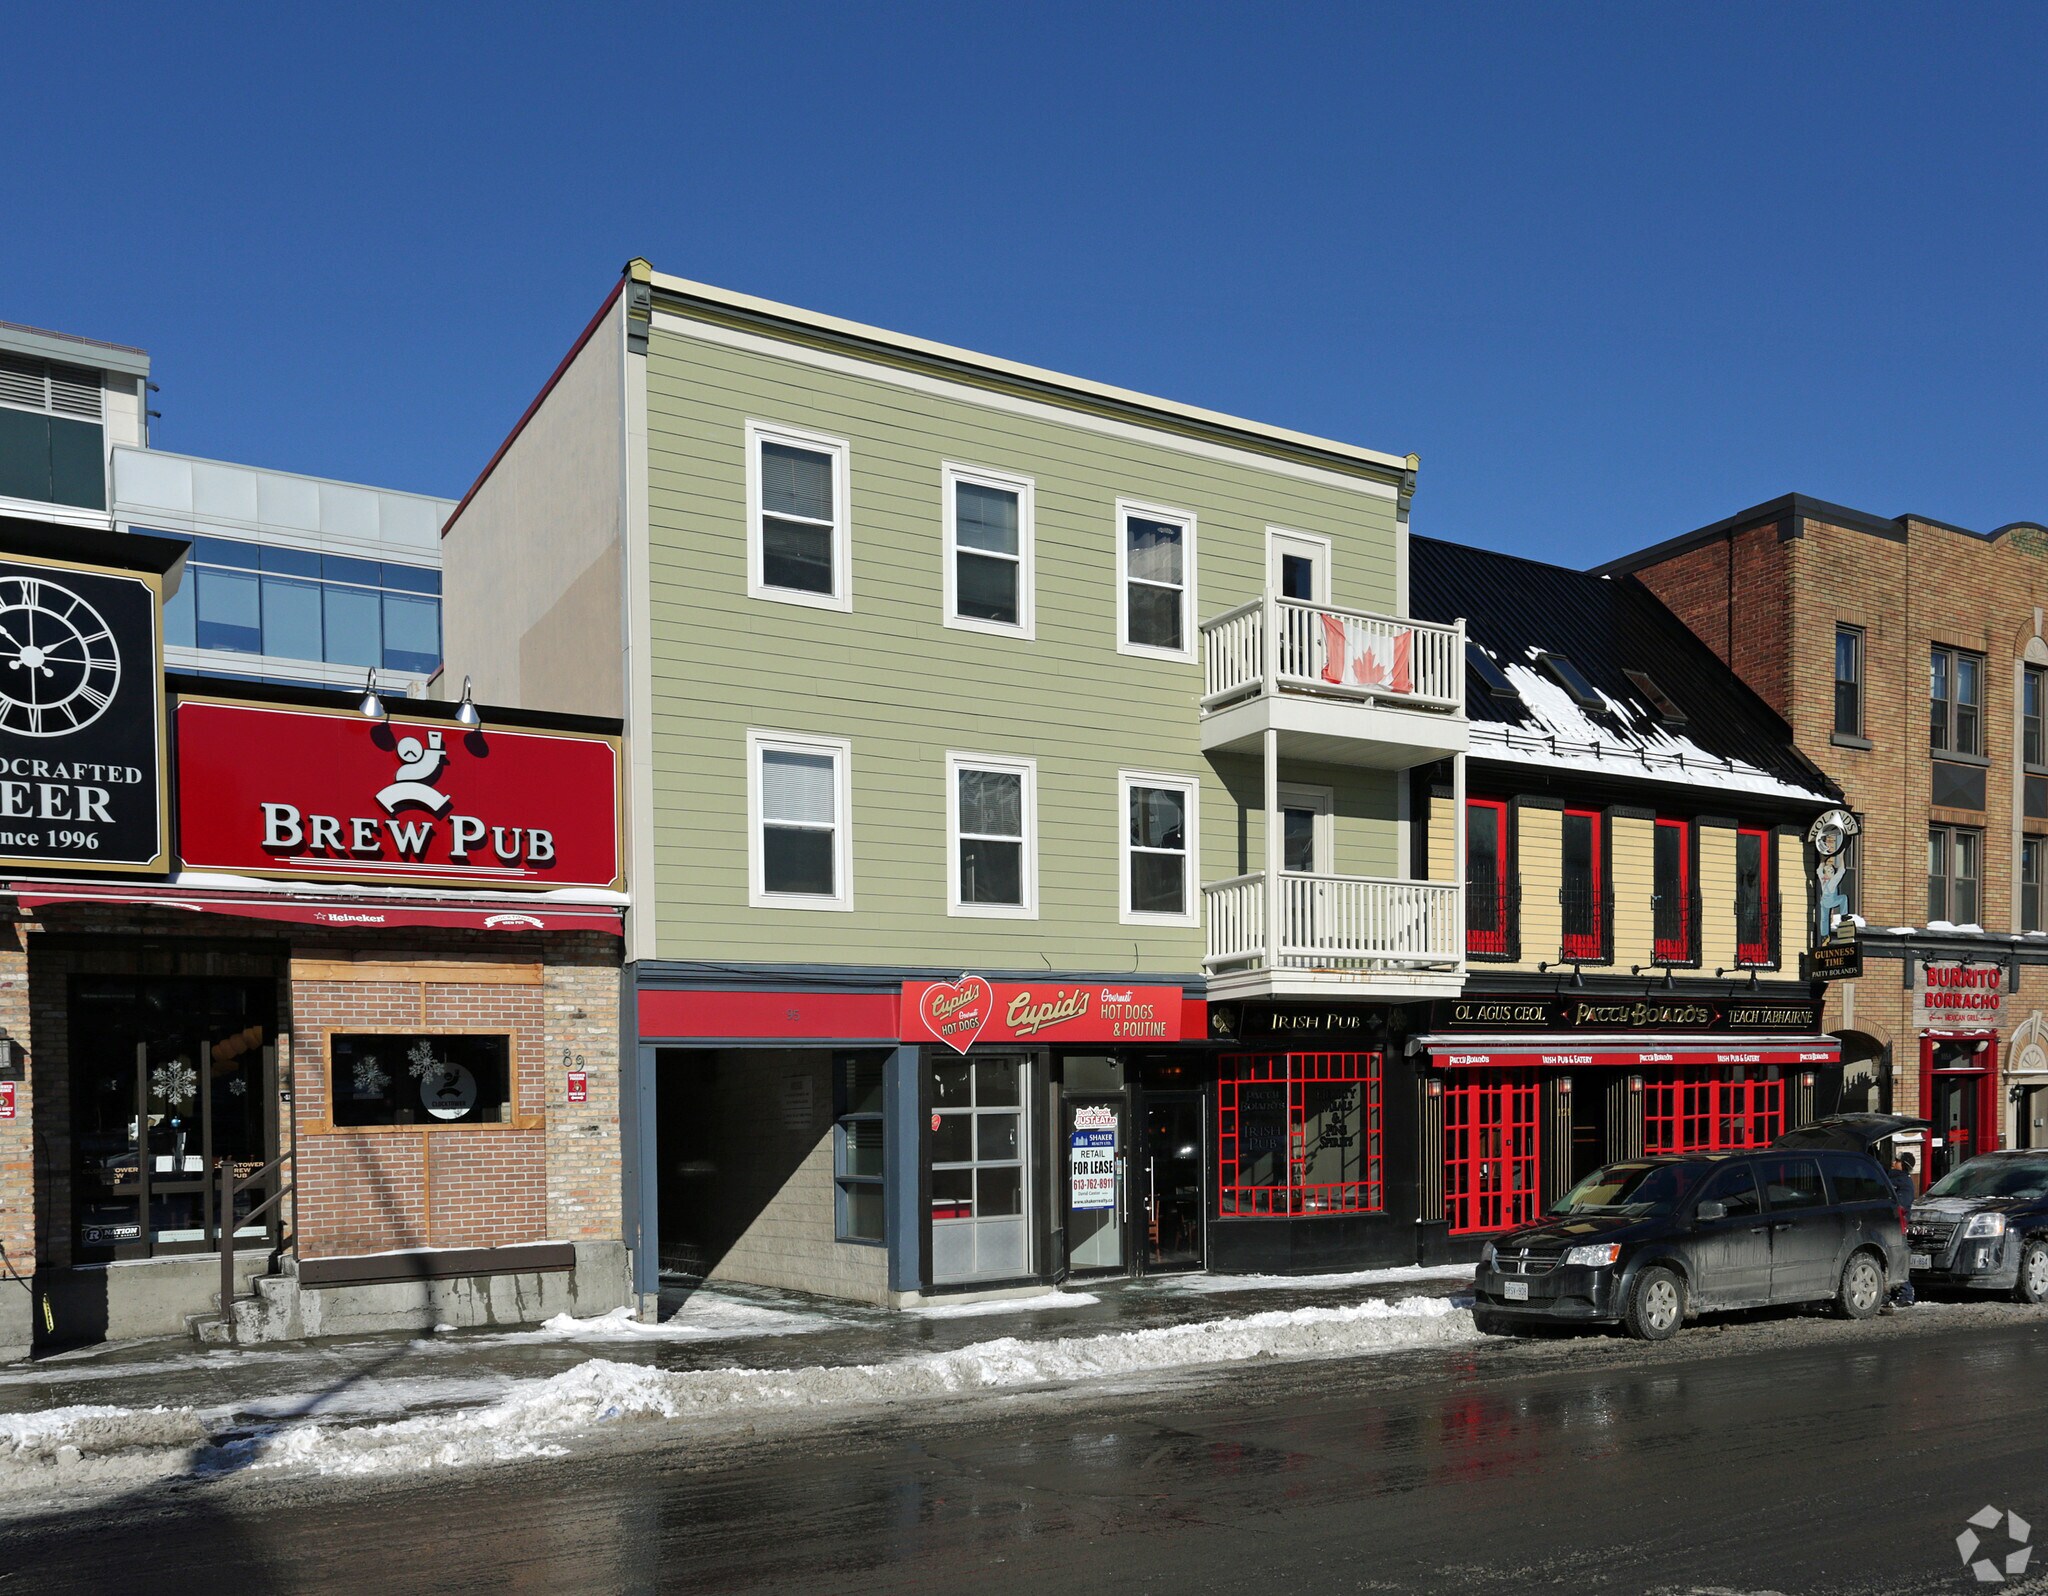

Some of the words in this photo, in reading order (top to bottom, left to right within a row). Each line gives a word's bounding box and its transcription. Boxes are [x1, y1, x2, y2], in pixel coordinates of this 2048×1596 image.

[0, 757, 142, 784] DCRAFTED
[0, 780, 116, 823] EER
[260, 802, 432, 853] BREW
[449, 815, 555, 861] PUB
[0, 831, 39, 846] nce
[47, 829, 99, 850] 1996
[328, 914, 385, 923] Heineken
[1814, 947, 1855, 960] GUINNESS
[1825, 957, 1845, 967] TIME
[1812, 970, 1828, 978] PATTY
[1926, 967, 2000, 989] BURRITO
[932, 984, 980, 1017] Cupid's
[1100, 988, 1134, 1003] Gourmet
[1925, 992, 2000, 1010] BORRACHO
[785, 1008, 801, 1022] 95
[1006, 988, 1090, 1035] Cupid's
[1101, 1004, 1122, 1020] HOT
[1125, 1004, 1154, 1020] DOGS
[1455, 1005, 1473, 1021] OL
[1477, 1005, 1511, 1021] AGUS
[1514, 1006, 1547, 1022] CEOL
[1728, 1009, 1759, 1024] TEACH
[1761, 1009, 1813, 1024] TABHAIRNE
[1945, 1014, 1966, 1022] MEXICAN
[1967, 1014, 1978, 1022] GRILL
[941, 1023, 957, 1036] HOT
[958, 1017, 980, 1032] DOGS
[1113, 1022, 1121, 1037] &
[1123, 1021, 1167, 1037] POUTINE
[1271, 1013, 1319, 1031] IRISH
[1326, 1012, 1361, 1030] PUB
[563, 1048, 585, 1073] 89
[1542, 1055, 1557, 1064] IRISH
[1557, 1055, 1569, 1064] PUB
[1574, 1055, 1593, 1064] EATERY
[1717, 1054, 1730, 1062] IRISH
[1730, 1054, 1740, 1062] PUB
[1744, 1054, 1760, 1062] EATERY
[1076, 1116, 1095, 1124] JUST
[1089, 1133, 1113, 1141] SHAKER
[1249, 1138, 1278, 1151] PUB
[1080, 1150, 1106, 1158] RETAIL
[1073, 1161, 1088, 1175] FOR
[1090, 1160, 1113, 1174] LEASE
[1073, 1178, 1113, 1191] 613-762-8911
[104, 1227, 138, 1236] NATION
